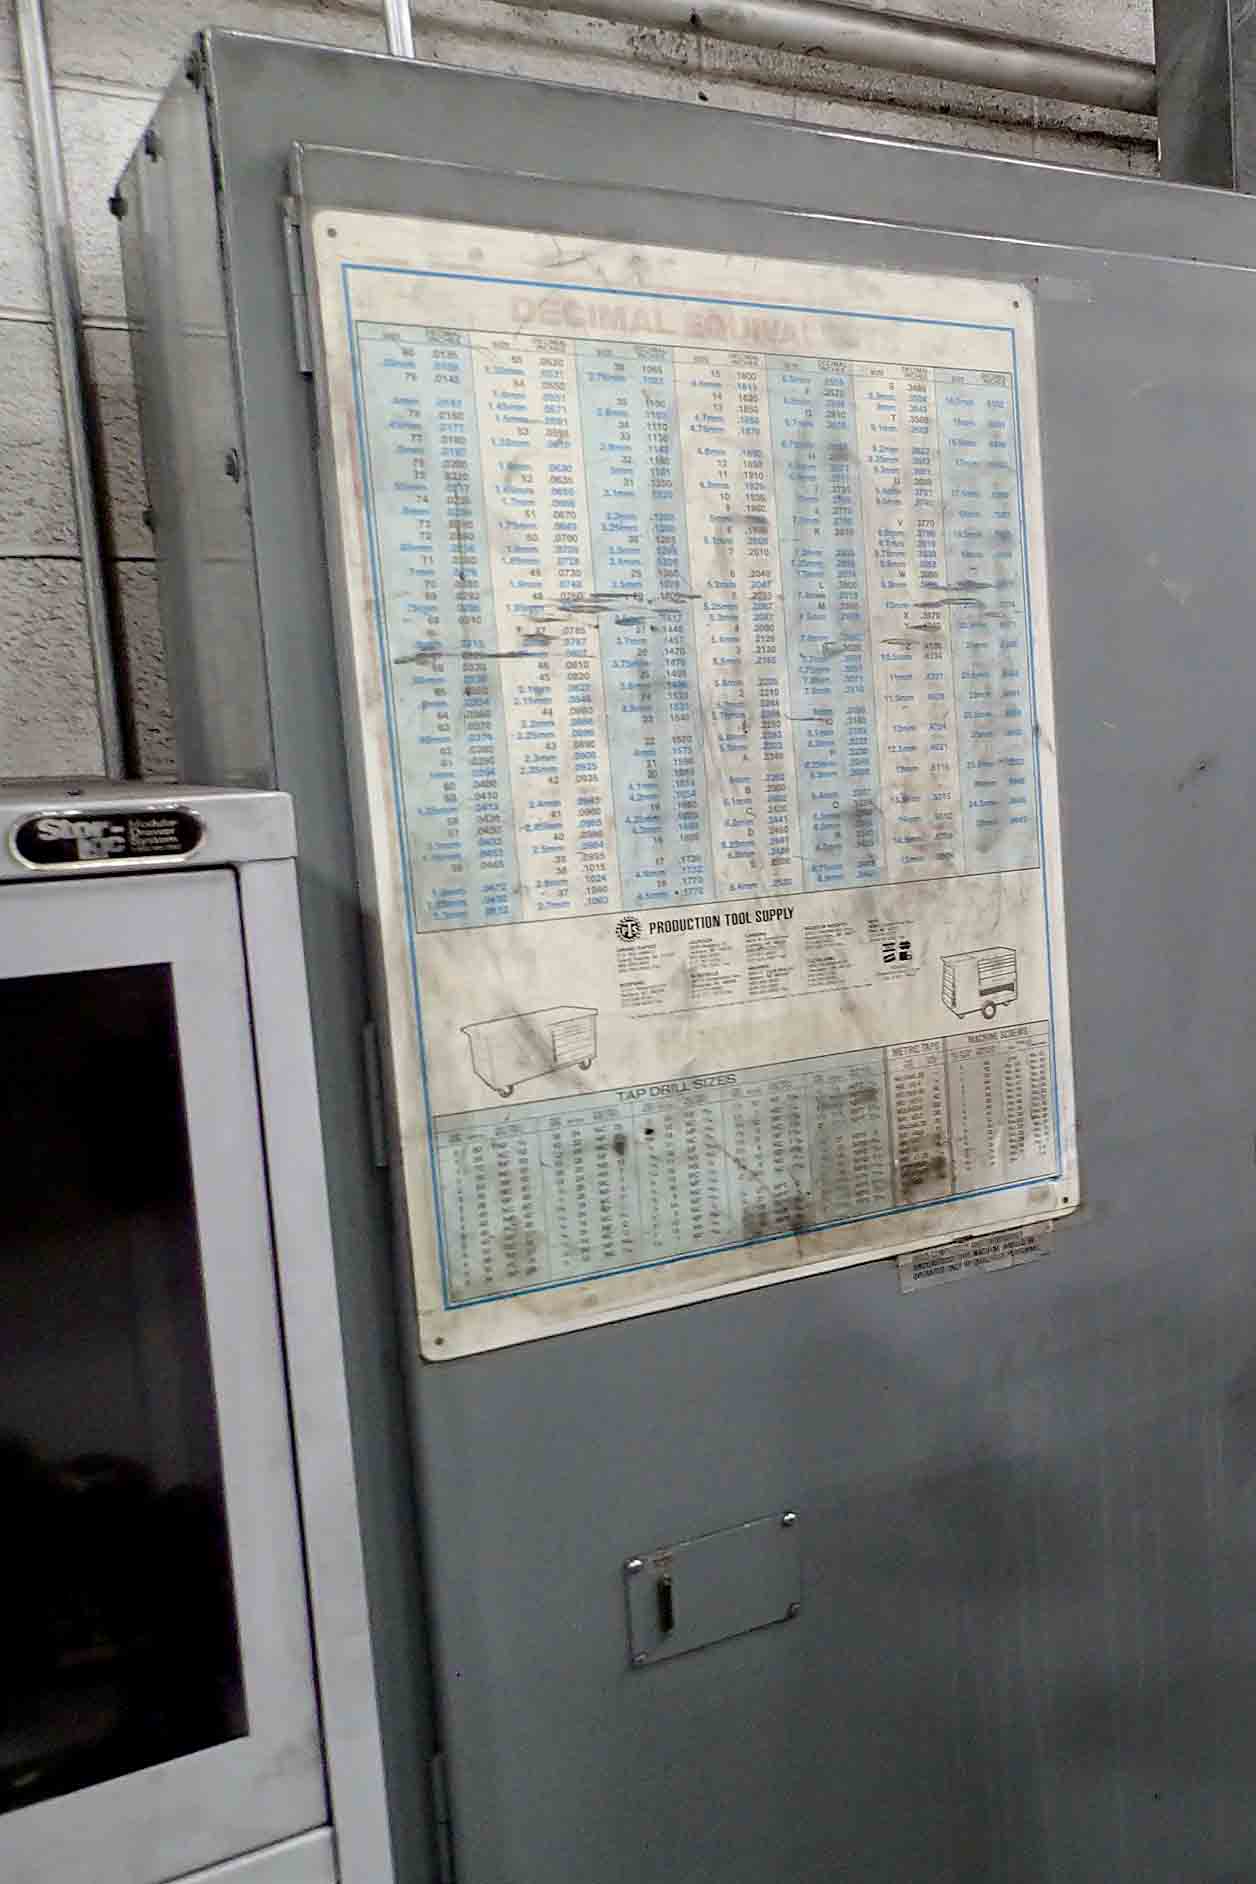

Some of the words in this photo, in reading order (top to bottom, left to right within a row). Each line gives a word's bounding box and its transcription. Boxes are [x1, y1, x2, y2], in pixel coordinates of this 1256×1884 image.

[650, 914, 720, 935] PRODUCTION
[726, 911, 752, 926] TOOL
[755, 906, 795, 923] SUPPLY
[616, 1087, 646, 1102] TAP
[648, 1080, 692, 1097] DRILL
[692, 1072, 736, 1089] SIZES
